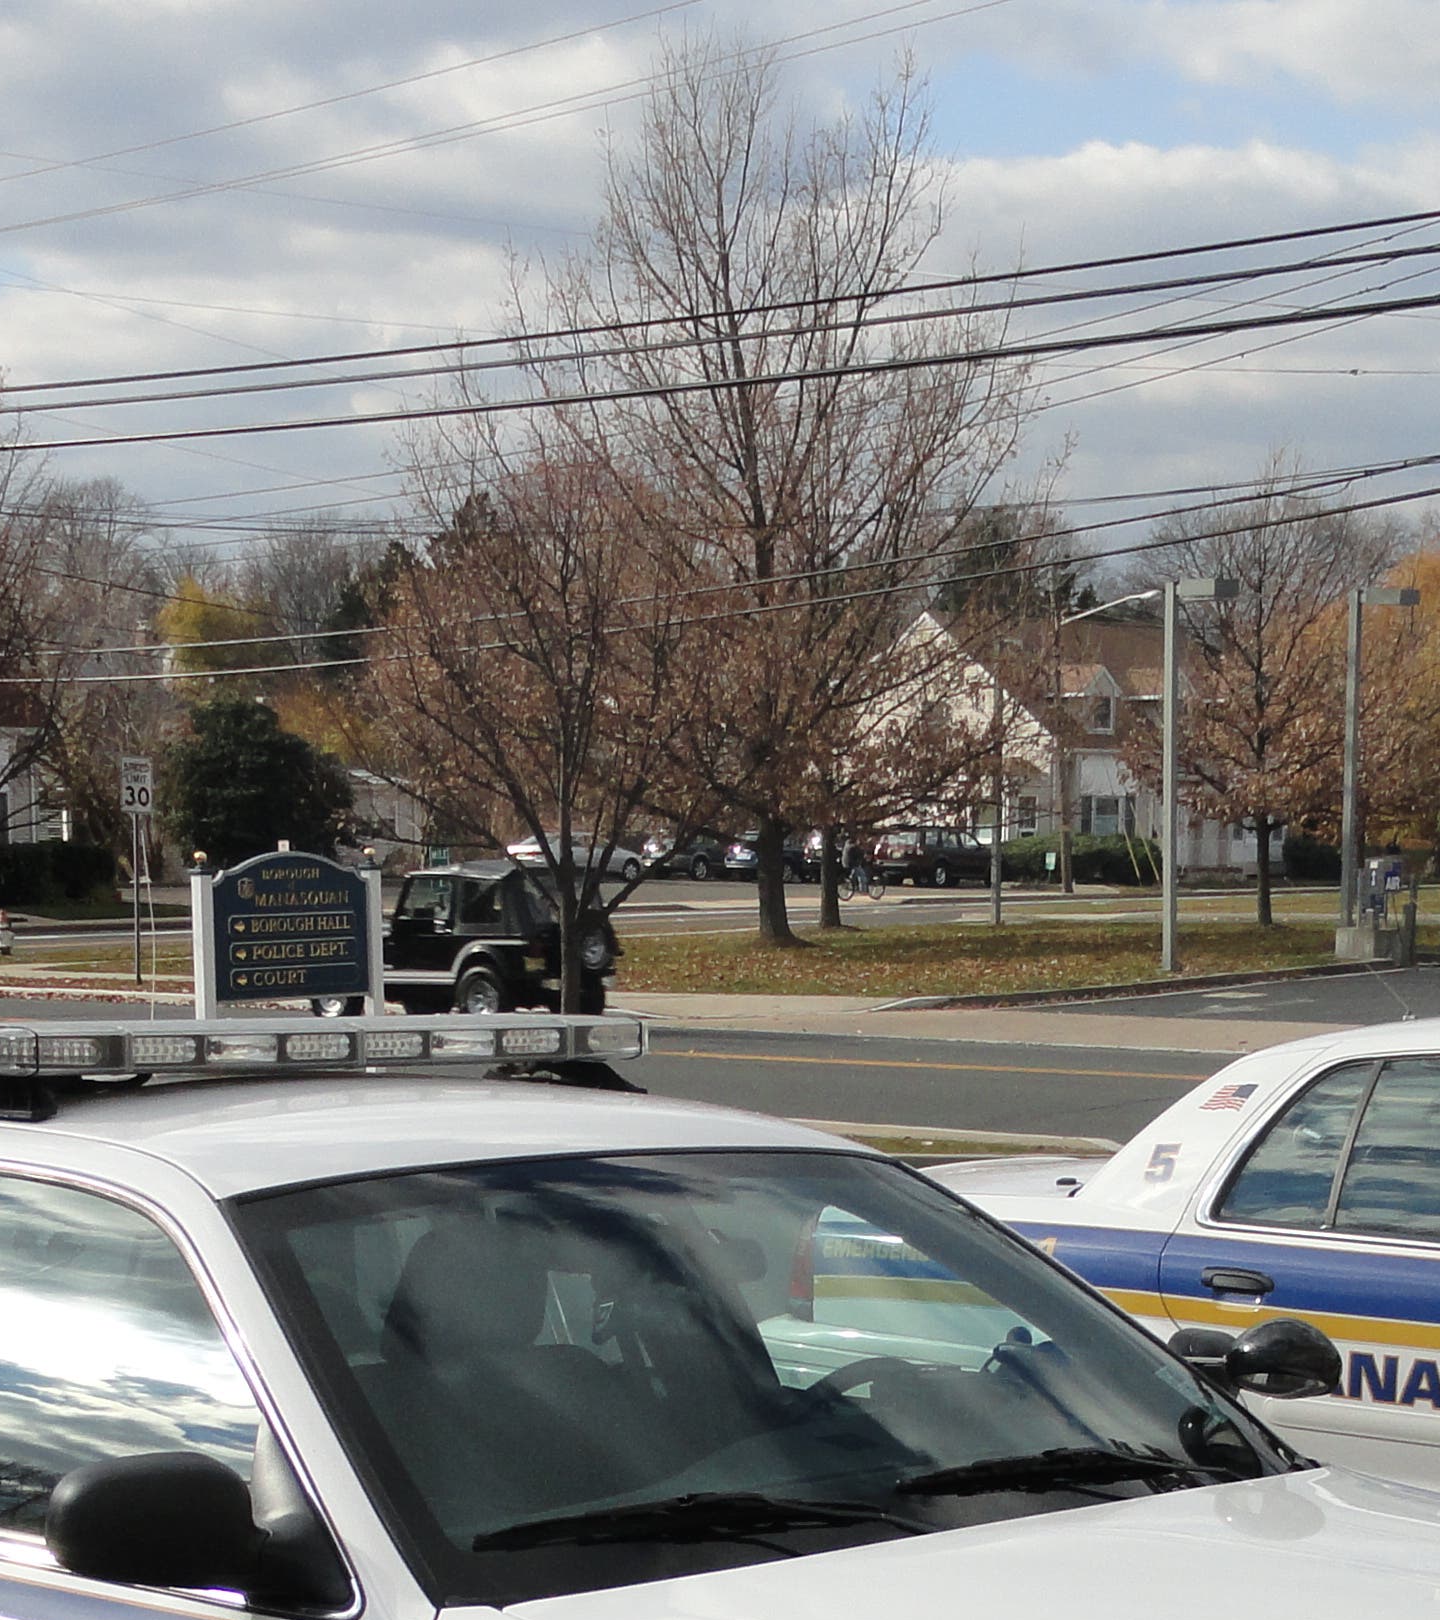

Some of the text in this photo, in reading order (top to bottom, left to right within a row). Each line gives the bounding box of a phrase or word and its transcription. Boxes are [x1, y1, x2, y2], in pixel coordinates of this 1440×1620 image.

[126, 774, 147, 784] LIMIT
[124, 786, 149, 806] 30
[262, 868, 320, 880] BOROUGH
[255, 890, 349, 907] MANASQUAN
[251, 915, 351, 933] BOROUGH HALL
[252, 941, 349, 960] POLICE DEPT.
[253, 969, 307, 986] COURT
[1143, 1142, 1182, 1184] 5
